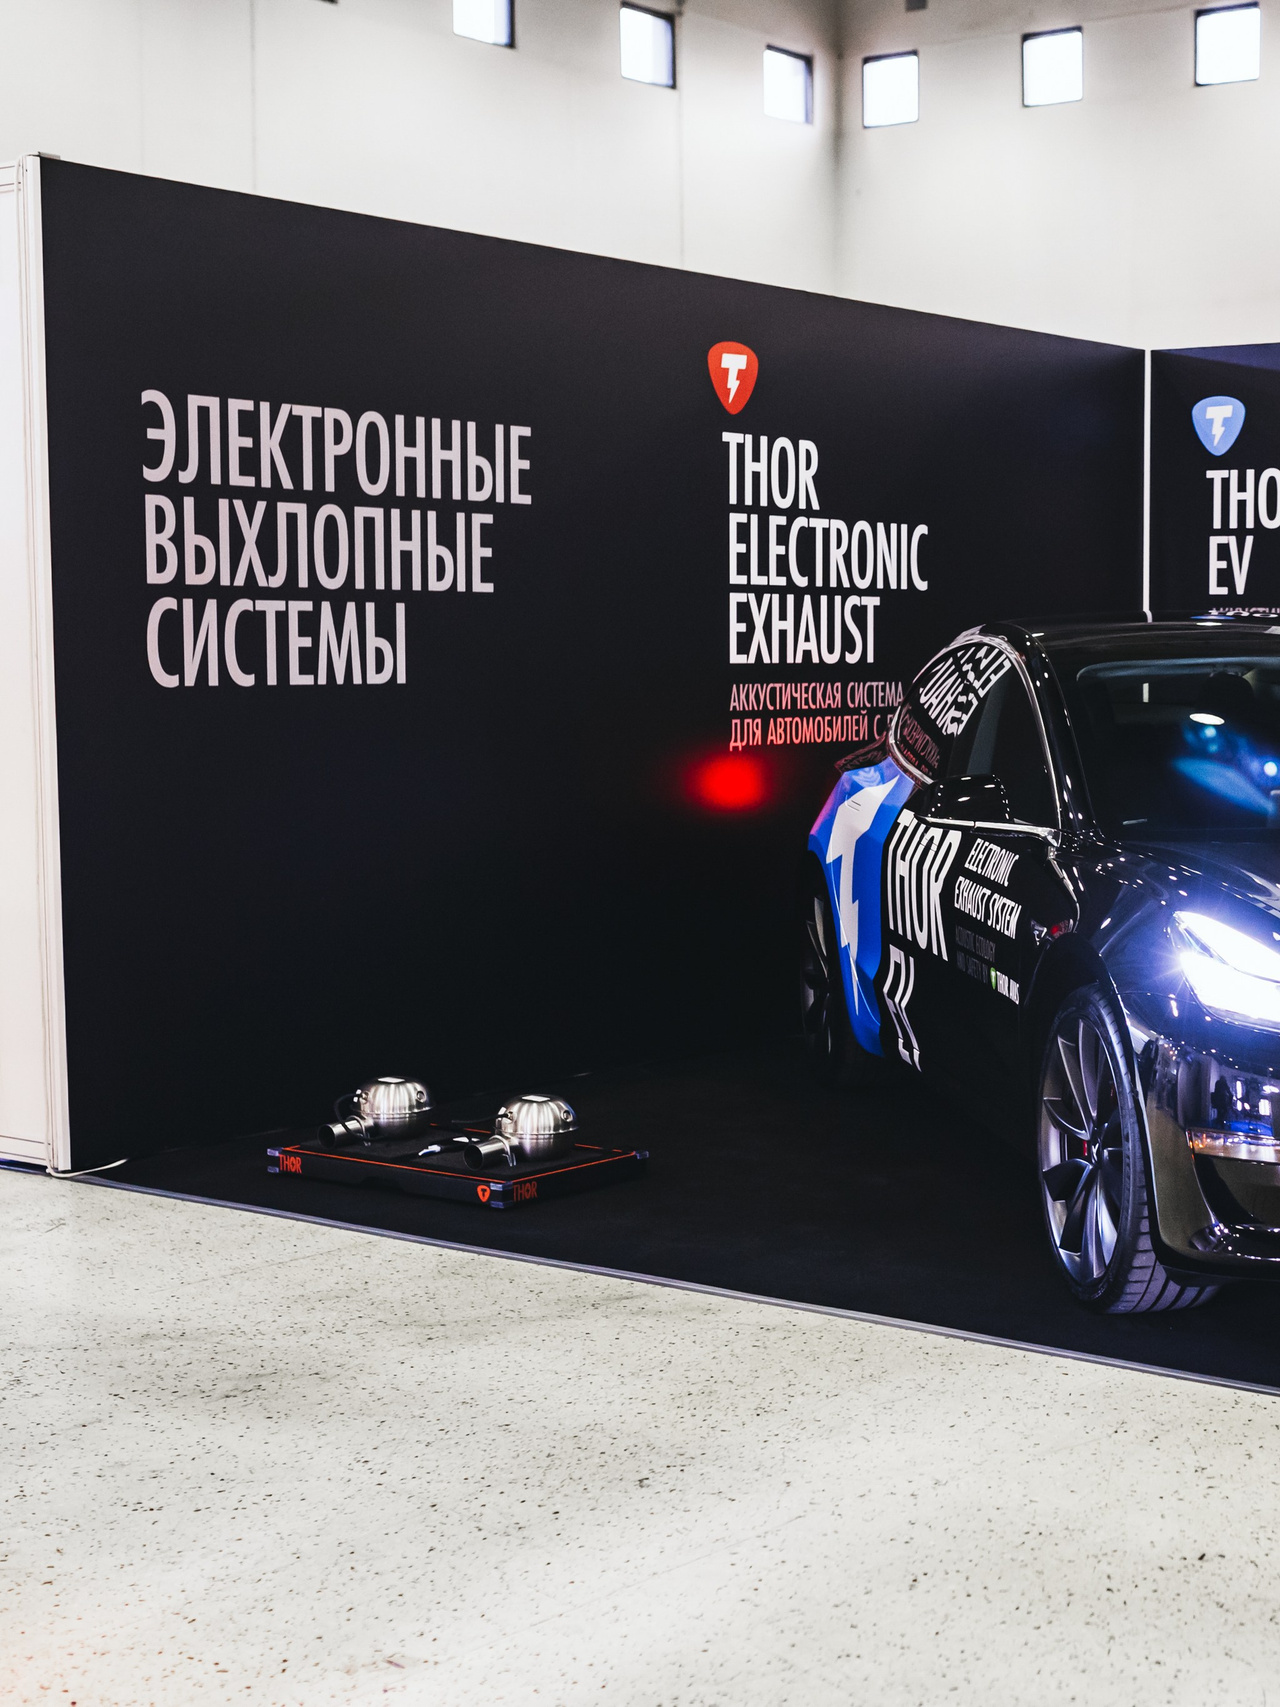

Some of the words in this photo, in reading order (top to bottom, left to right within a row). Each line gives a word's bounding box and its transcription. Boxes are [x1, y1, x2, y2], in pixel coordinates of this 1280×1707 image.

[140, 388, 532, 505] ЭЛЕКТРОННЫЕ
[722, 431, 820, 510] THOR
[144, 494, 494, 593] ВЫХЛОПНЫЕ
[729, 512, 929, 592] ELECTRONIC
[1208, 535, 1254, 596] EV
[146, 596, 406, 688] СИСТЕМЫ
[729, 592, 880, 664] EXHAUST
[729, 682, 842, 711] АККУСТИЧЕСКАЯ
[846, 681, 904, 708] СИСТЕМА
[729, 718, 762, 752] ДЛЯ
[767, 709, 869, 746] АВТОМОБИЛЕЙ
[873, 714, 882, 741] С
[886, 808, 962, 962] THOR
[964, 838, 1020, 888] ELECTRONIC
[954, 875, 992, 922] EXHAUST
[987, 893, 1022, 940] SYSTEM
[278, 1153, 303, 1174] THOR
[513, 1181, 538, 1202] THOR
